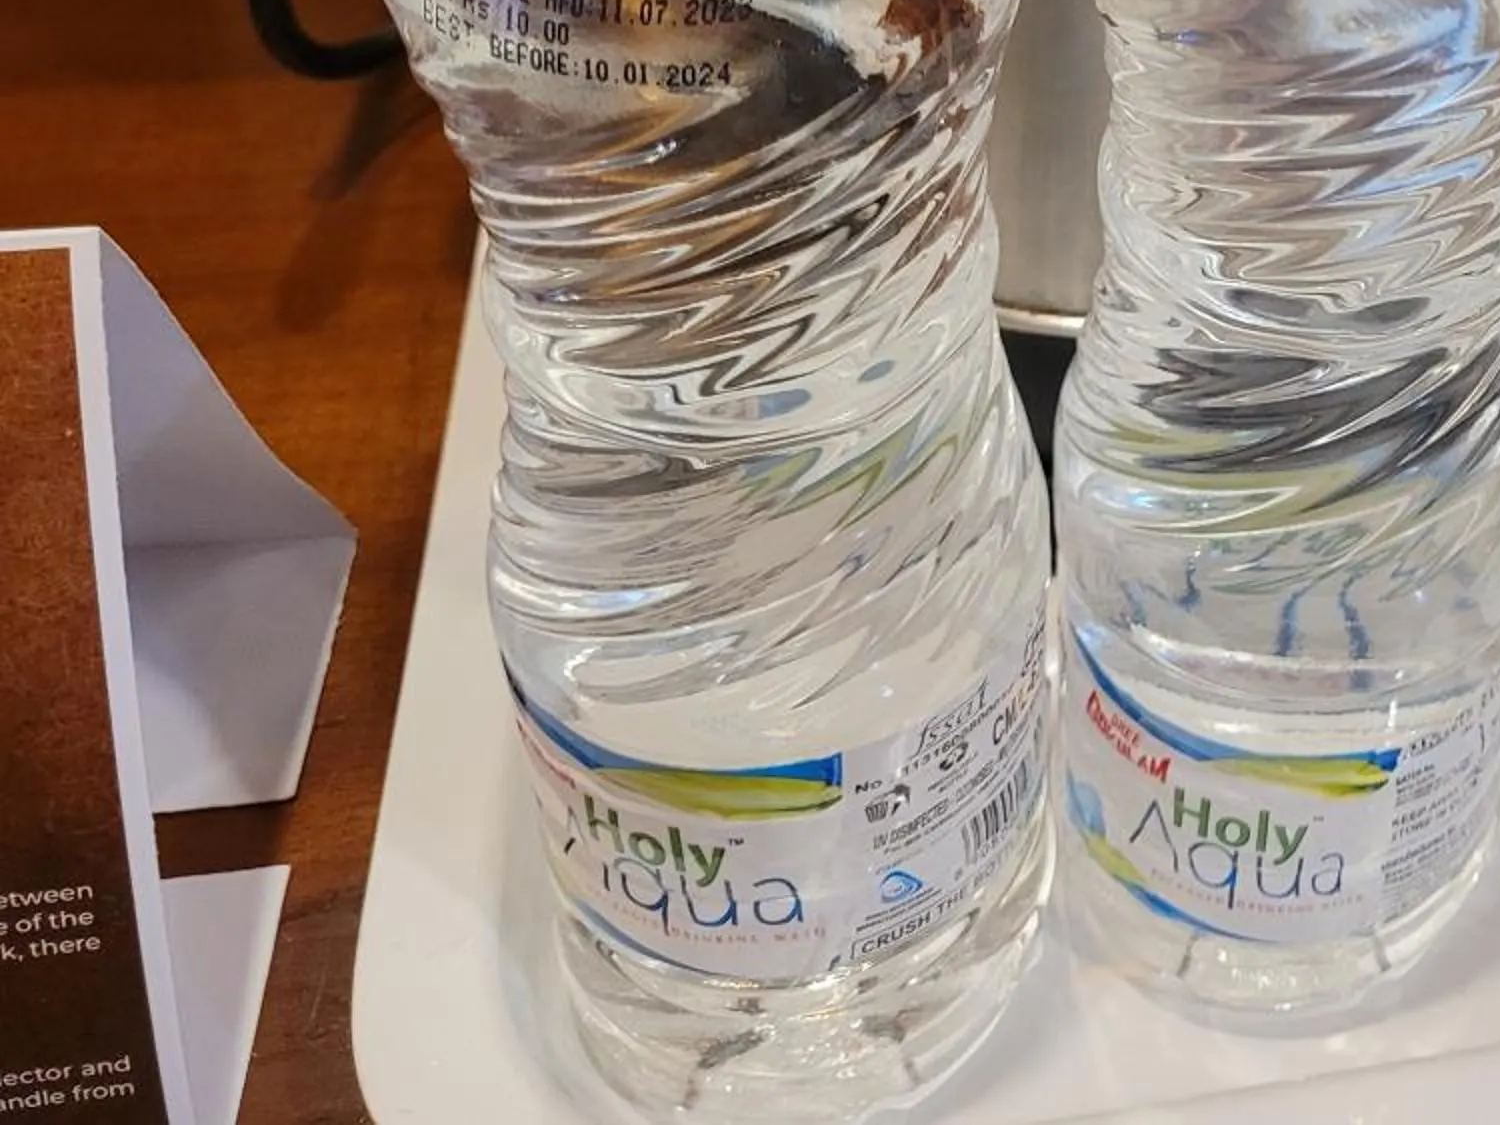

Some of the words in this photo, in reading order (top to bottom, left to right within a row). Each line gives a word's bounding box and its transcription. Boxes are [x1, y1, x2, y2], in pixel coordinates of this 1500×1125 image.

[584, 794, 725, 888] Holy
[1173, 786, 1310, 866] Holy
[1128, 799, 1345, 910] Aqua
[15, 912, 43, 933] of
[48, 910, 95, 930] the
[860, 910, 932, 956] CRUSH
[29, 936, 101, 958] there
[0, 1064, 73, 1088] ector
[81, 1054, 131, 1077] and
[71, 1082, 135, 1103] from
